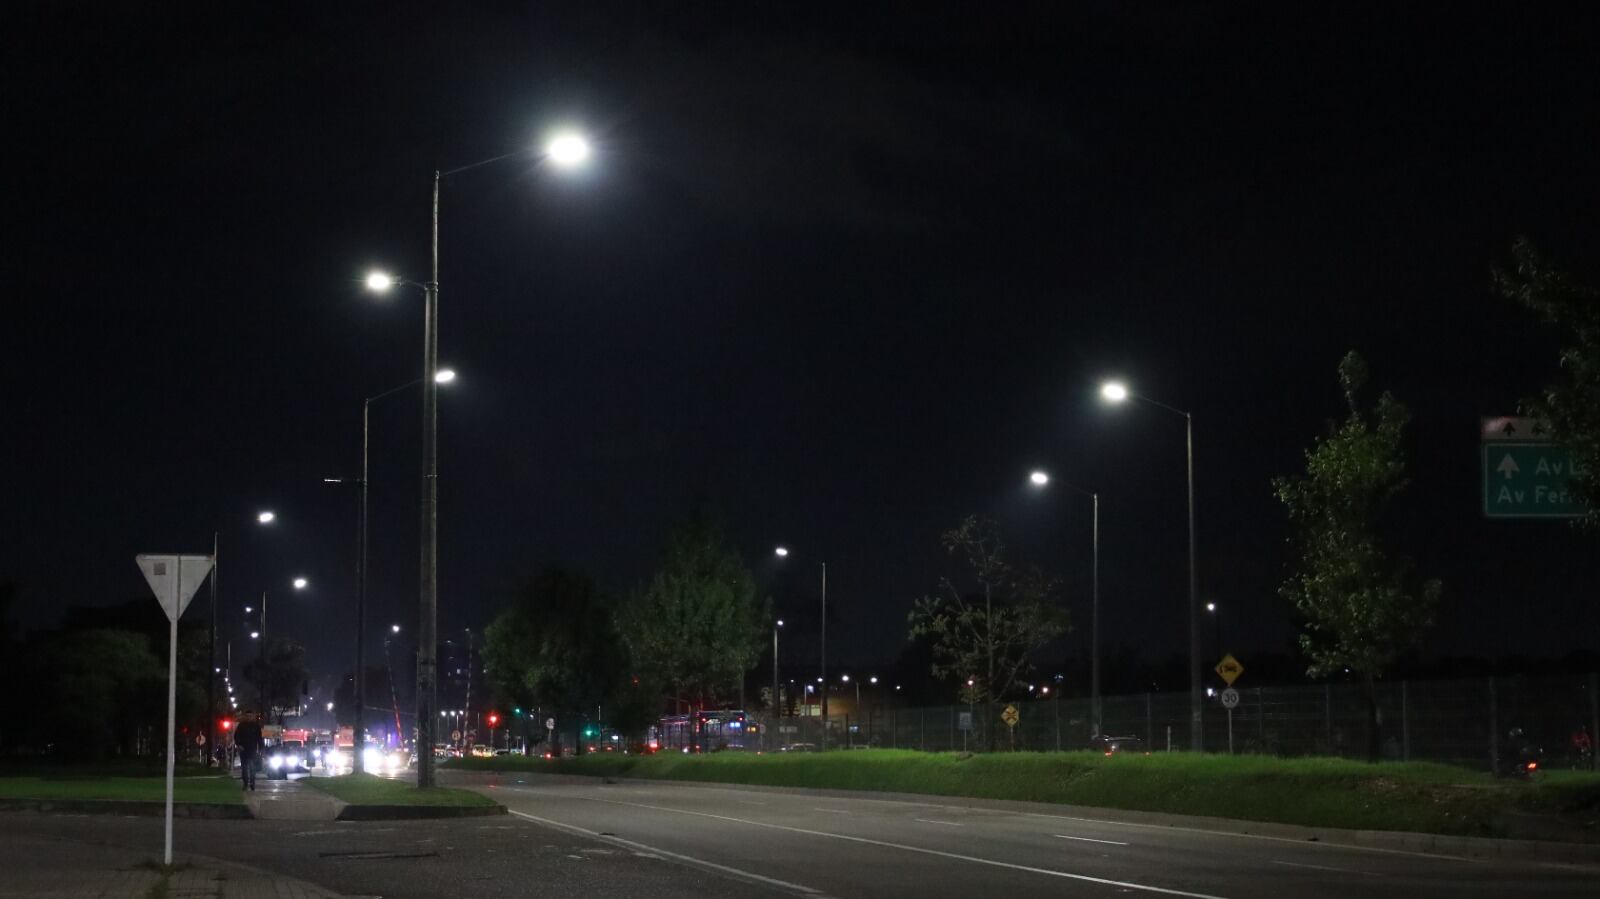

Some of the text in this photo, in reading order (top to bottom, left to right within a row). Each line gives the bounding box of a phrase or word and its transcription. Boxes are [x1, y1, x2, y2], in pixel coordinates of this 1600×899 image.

[1535, 456, 1563, 476] Av
[1497, 485, 1525, 504] Av
[1224, 693, 1237, 703] 30
